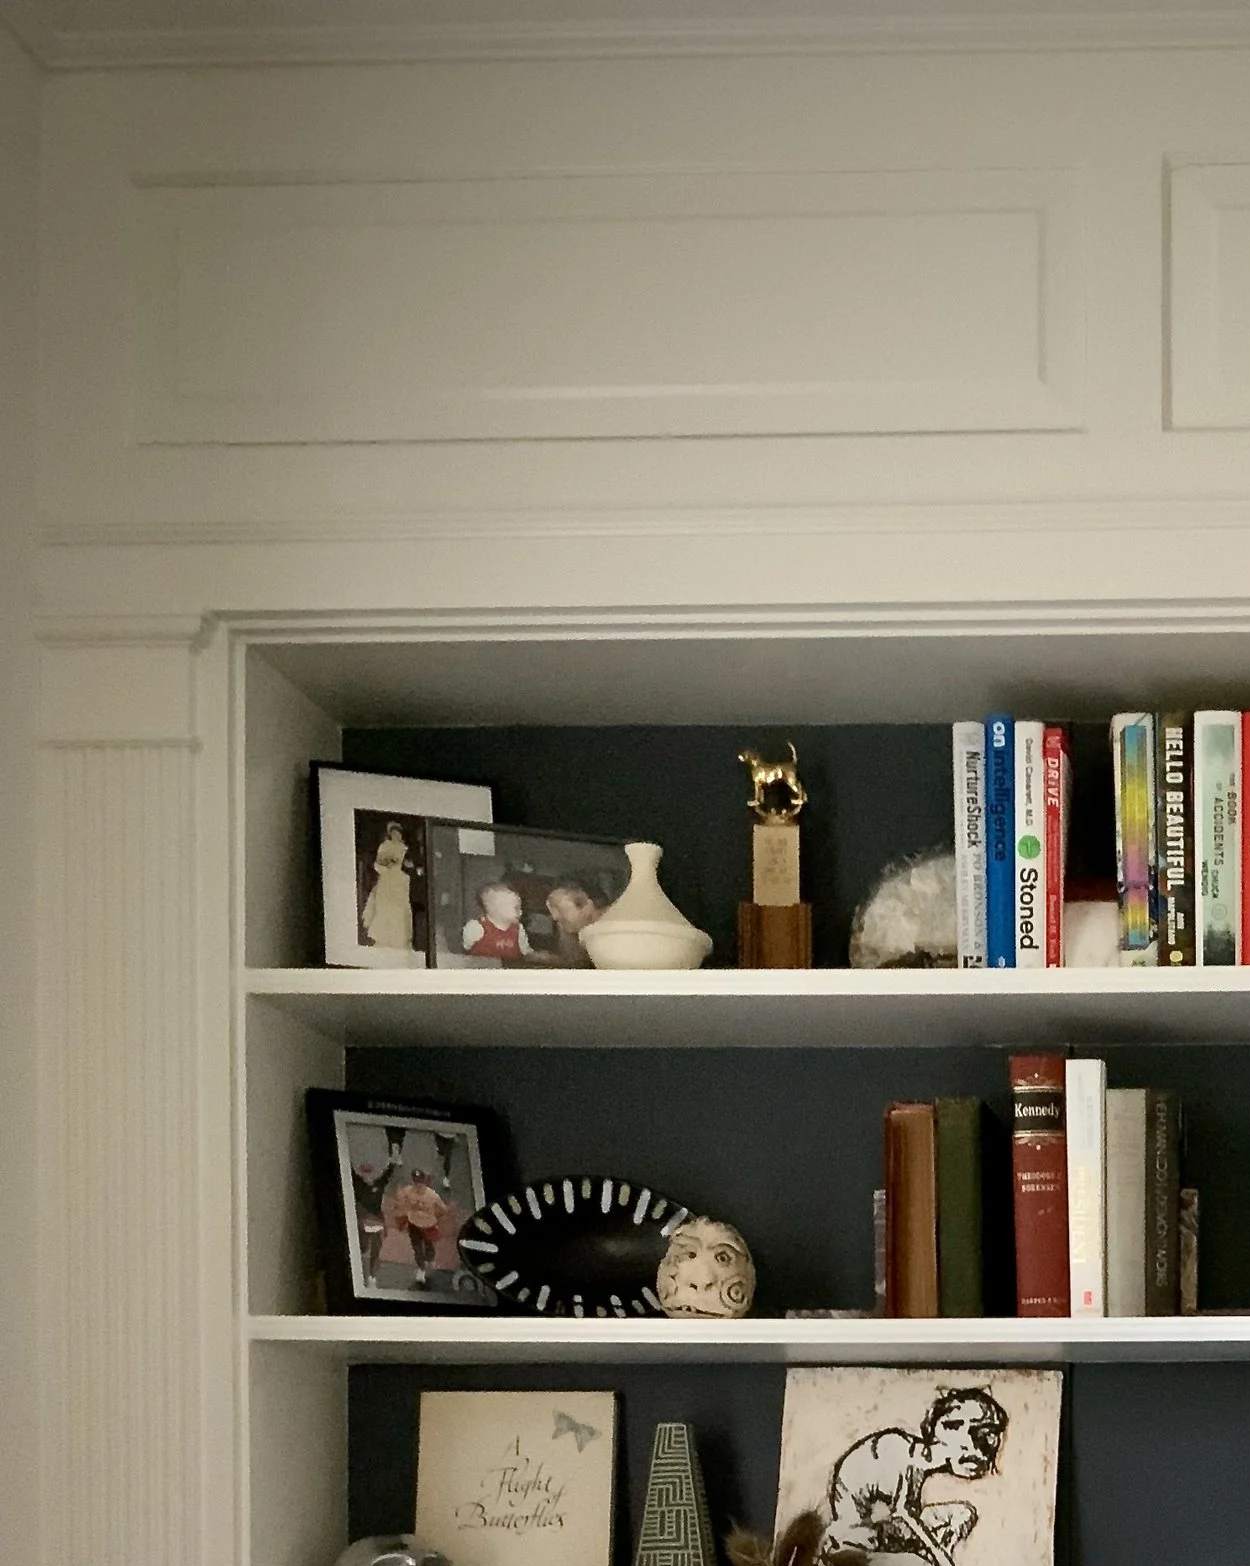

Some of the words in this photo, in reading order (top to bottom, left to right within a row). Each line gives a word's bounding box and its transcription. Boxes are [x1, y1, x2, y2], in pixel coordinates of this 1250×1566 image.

[993, 721, 1006, 747] on
[1165, 727, 1183, 783] HELLO
[965, 751, 981, 848] NurtureShock
[990, 750, 1010, 861] intelligence
[1227, 792, 1236, 824] BOOK
[1166, 791, 1185, 891] BEAUTIFUL
[1214, 797, 1224, 865] ACCIDENTS
[1020, 868, 1039, 950] Stoned
[1211, 869, 1219, 899] CHUCK
[1014, 1103, 1060, 1118] Kennedy
